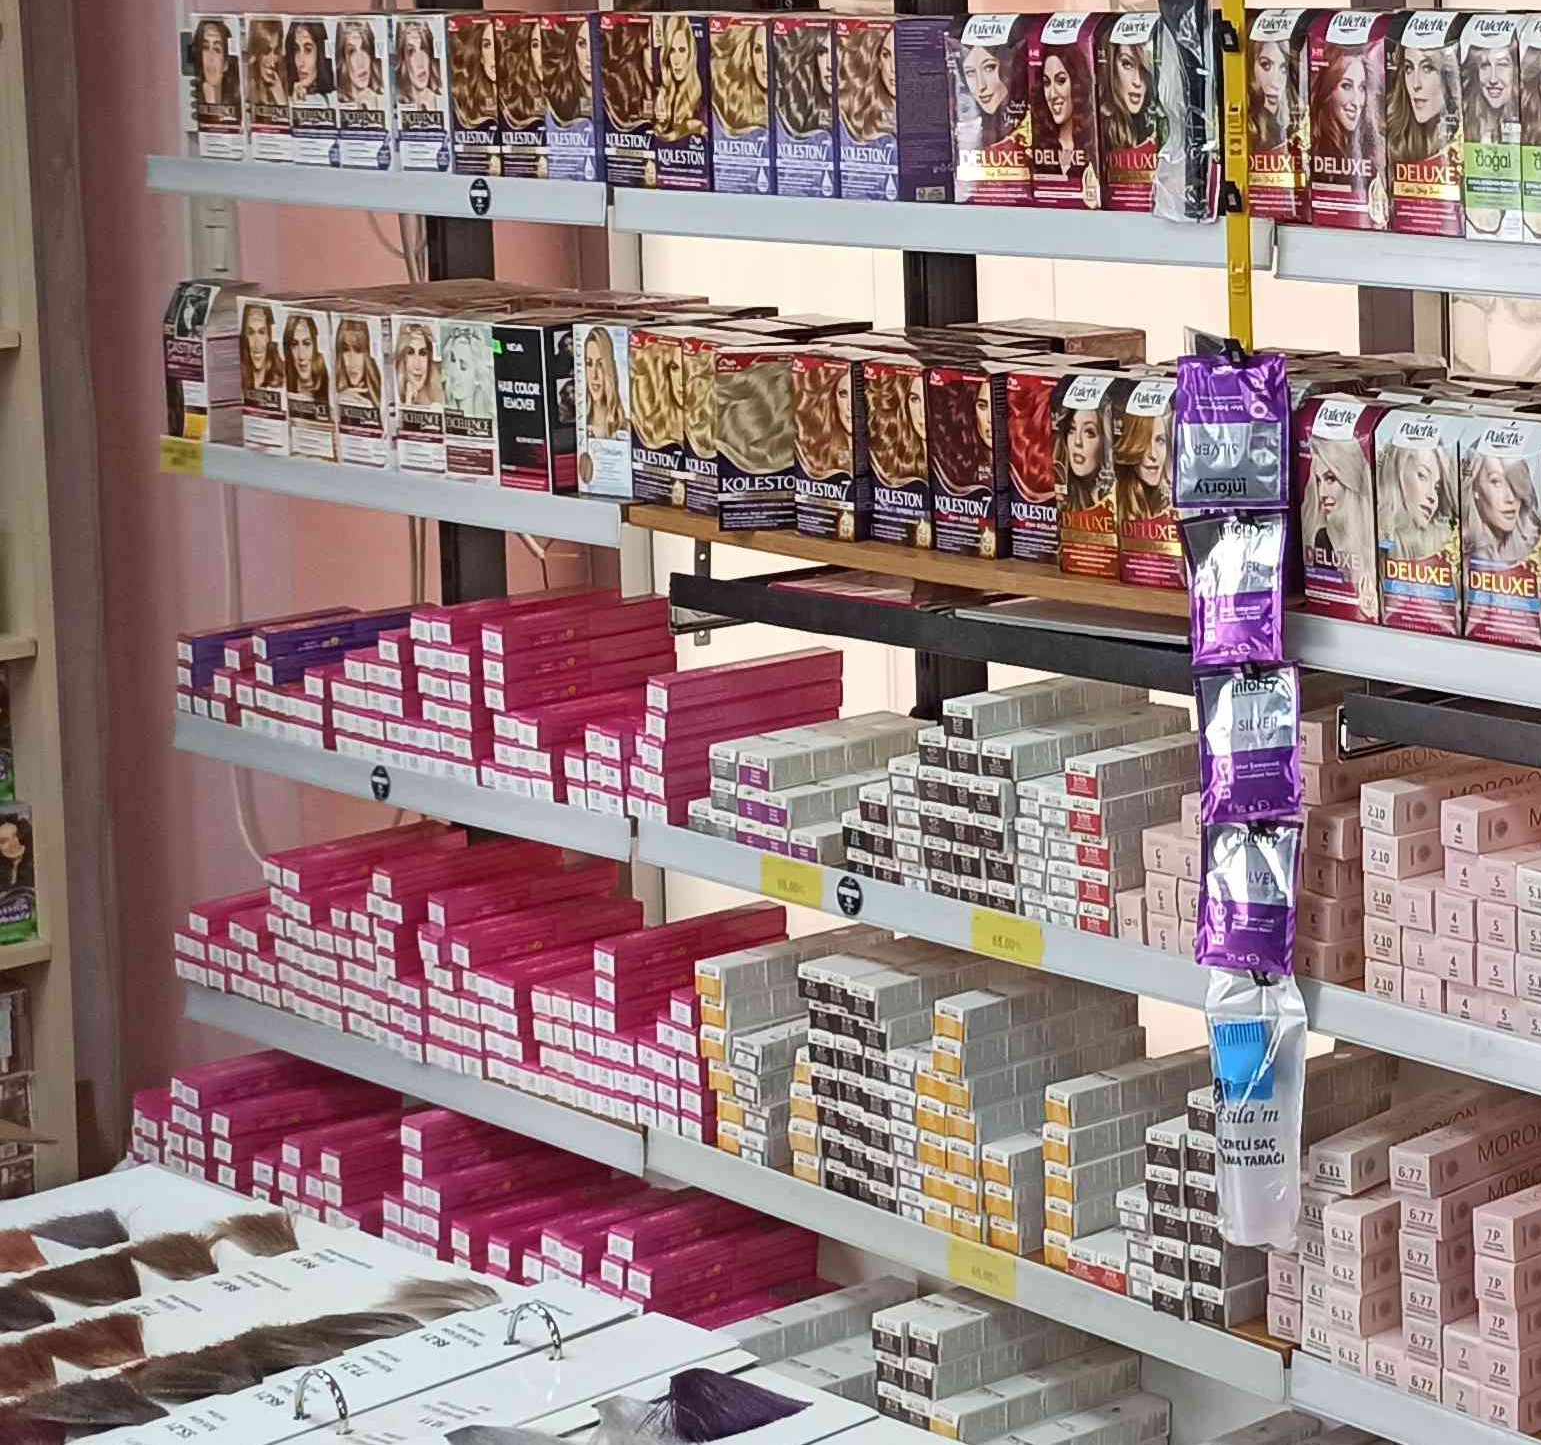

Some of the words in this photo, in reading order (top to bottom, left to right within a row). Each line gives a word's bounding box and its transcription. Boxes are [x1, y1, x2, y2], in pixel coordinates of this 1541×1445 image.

[1313, 155, 1372, 177] DELUXE
[874, 487, 924, 509] KOLESTON
[1386, 559, 1452, 587] DELUXE
[1469, 570, 1535, 597] DELUXE
[1254, 1138, 1276, 1151] SAÇ
